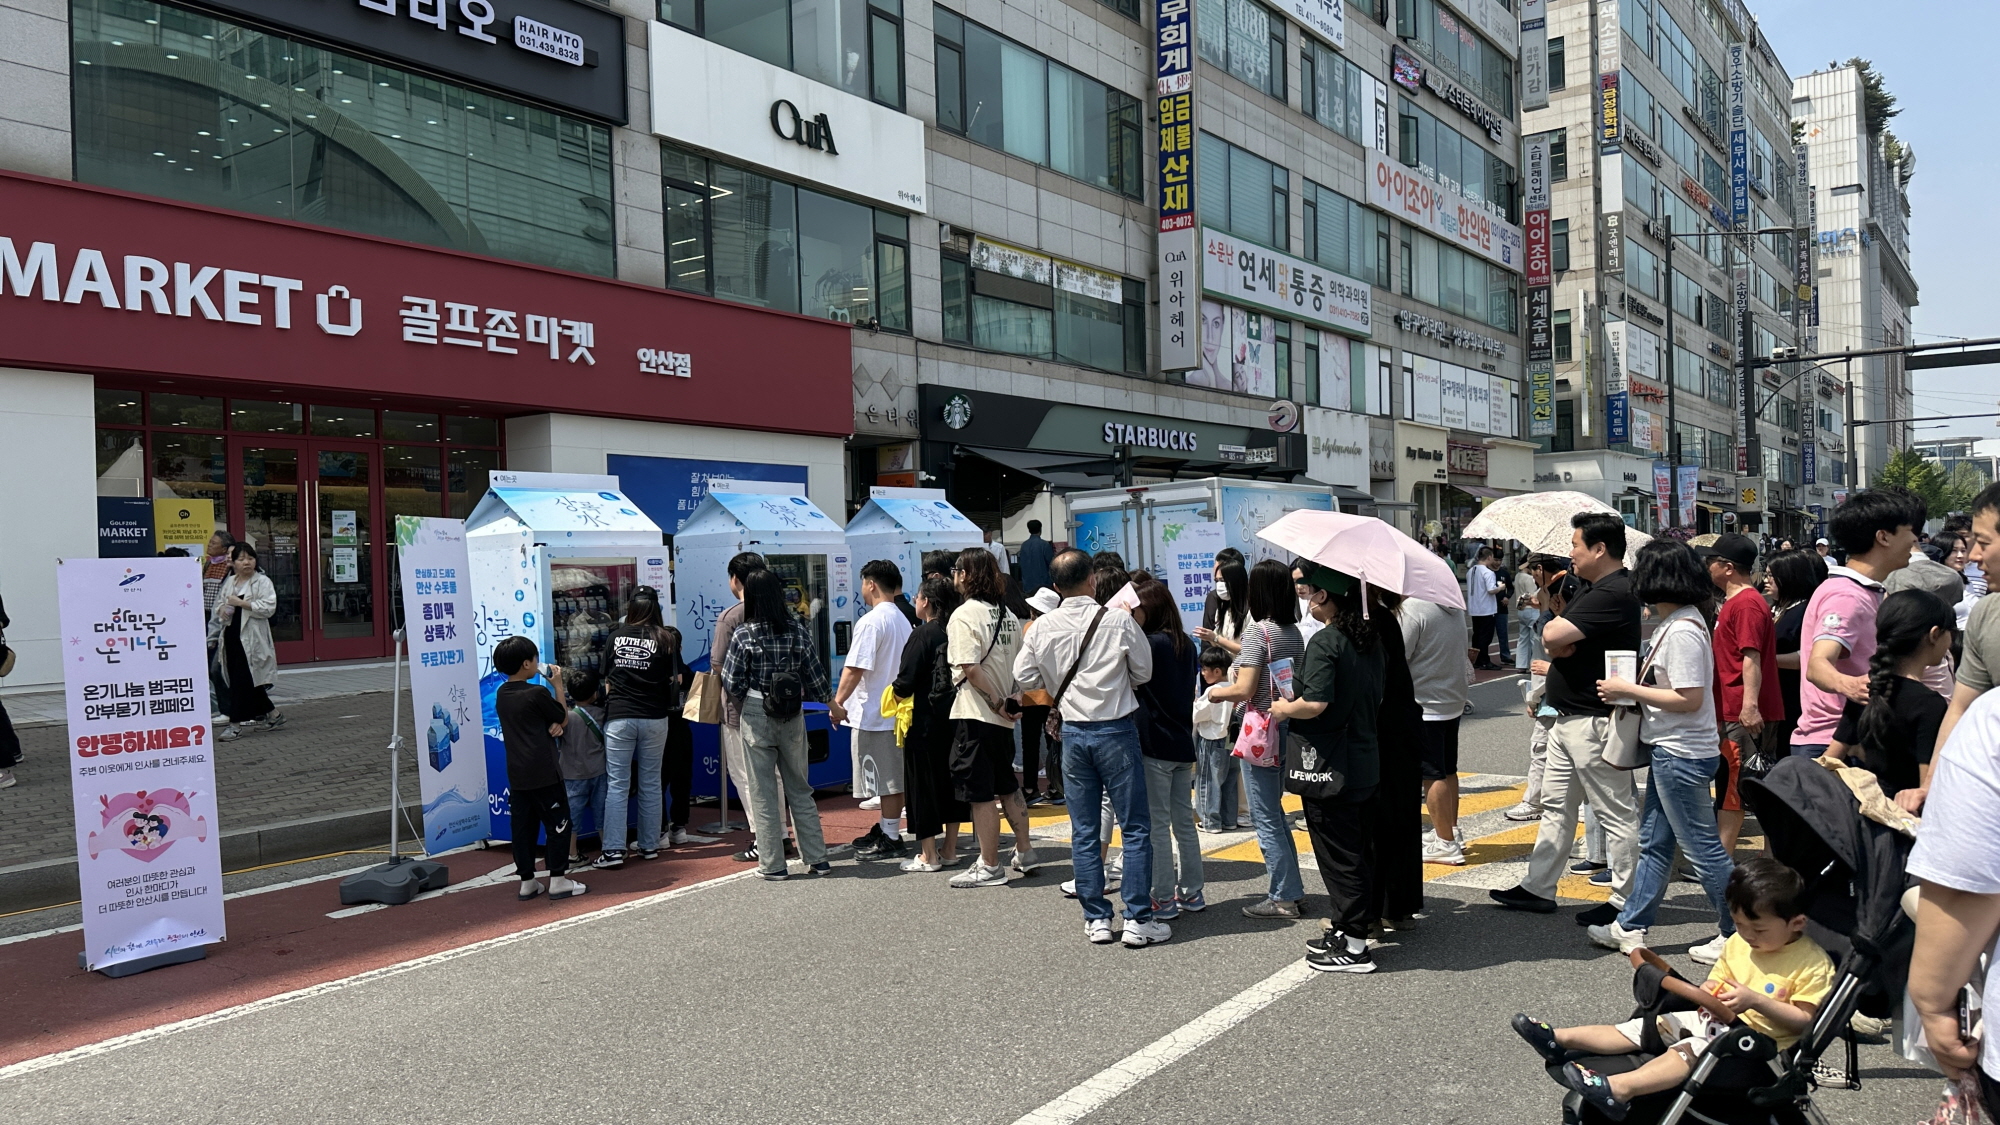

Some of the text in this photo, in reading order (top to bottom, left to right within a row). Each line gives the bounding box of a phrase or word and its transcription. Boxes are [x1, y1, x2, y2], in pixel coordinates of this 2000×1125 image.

[1295, 3, 1304, 18] TEL
[1306, 12, 1333, 36] 411-8080
[519, 20, 579, 49] HAIR MTO
[519, 34, 580, 62] 031.439.8328
[1601, 57, 1617, 71] 8F
[1733, 132, 1745, 169] 세무사
[1377, 161, 1434, 224] 아이조아
[1457, 204, 1491, 251] 한의원
[1161, 214, 1191, 231] 403-0072
[1529, 212, 1547, 275] 아이조아
[0, 235, 303, 330] MARKET
[1208, 239, 1368, 312] 소문난 연세 통증 의학과의원
[1169, 270, 1185, 348] 위아헤어
[1531, 289, 1548, 347] 세계주류
[636, 347, 692, 378] 안산점
[1531, 372, 1552, 421] 부동산
[1104, 422, 1197, 451] STARBUCKS
[500, 475, 517, 483] 여는곳
[100, 528, 148, 537] MARKET
[415, 568, 456, 579] 안심하고 드세요
[1183, 573, 1212, 585] 종이팩
[416, 581, 457, 595] 안산 수돗물
[422, 602, 455, 621] 종이팩
[424, 621, 457, 643] 상록水
[96, 635, 177, 664] 온기나눔
[420, 649, 465, 668] 무료자판기
[83, 678, 193, 701] 온기나눔 범국민
[84, 696, 195, 721] 안부묻기 캠페인
[76, 725, 206, 758] 안녕하세요?
[79, 754, 206, 777] 주변 이웃에게 인사를 건네주세요.
[1289, 769, 1334, 783] LIFEWORK
[107, 866, 195, 890] 여러분의 따뜻한 관심과
[125, 880, 178, 898] 인사 한마디가
[98, 885, 208, 915] 더 따뜻한 안산시를 만듭니다!
[190, 928, 207, 938] 안산
